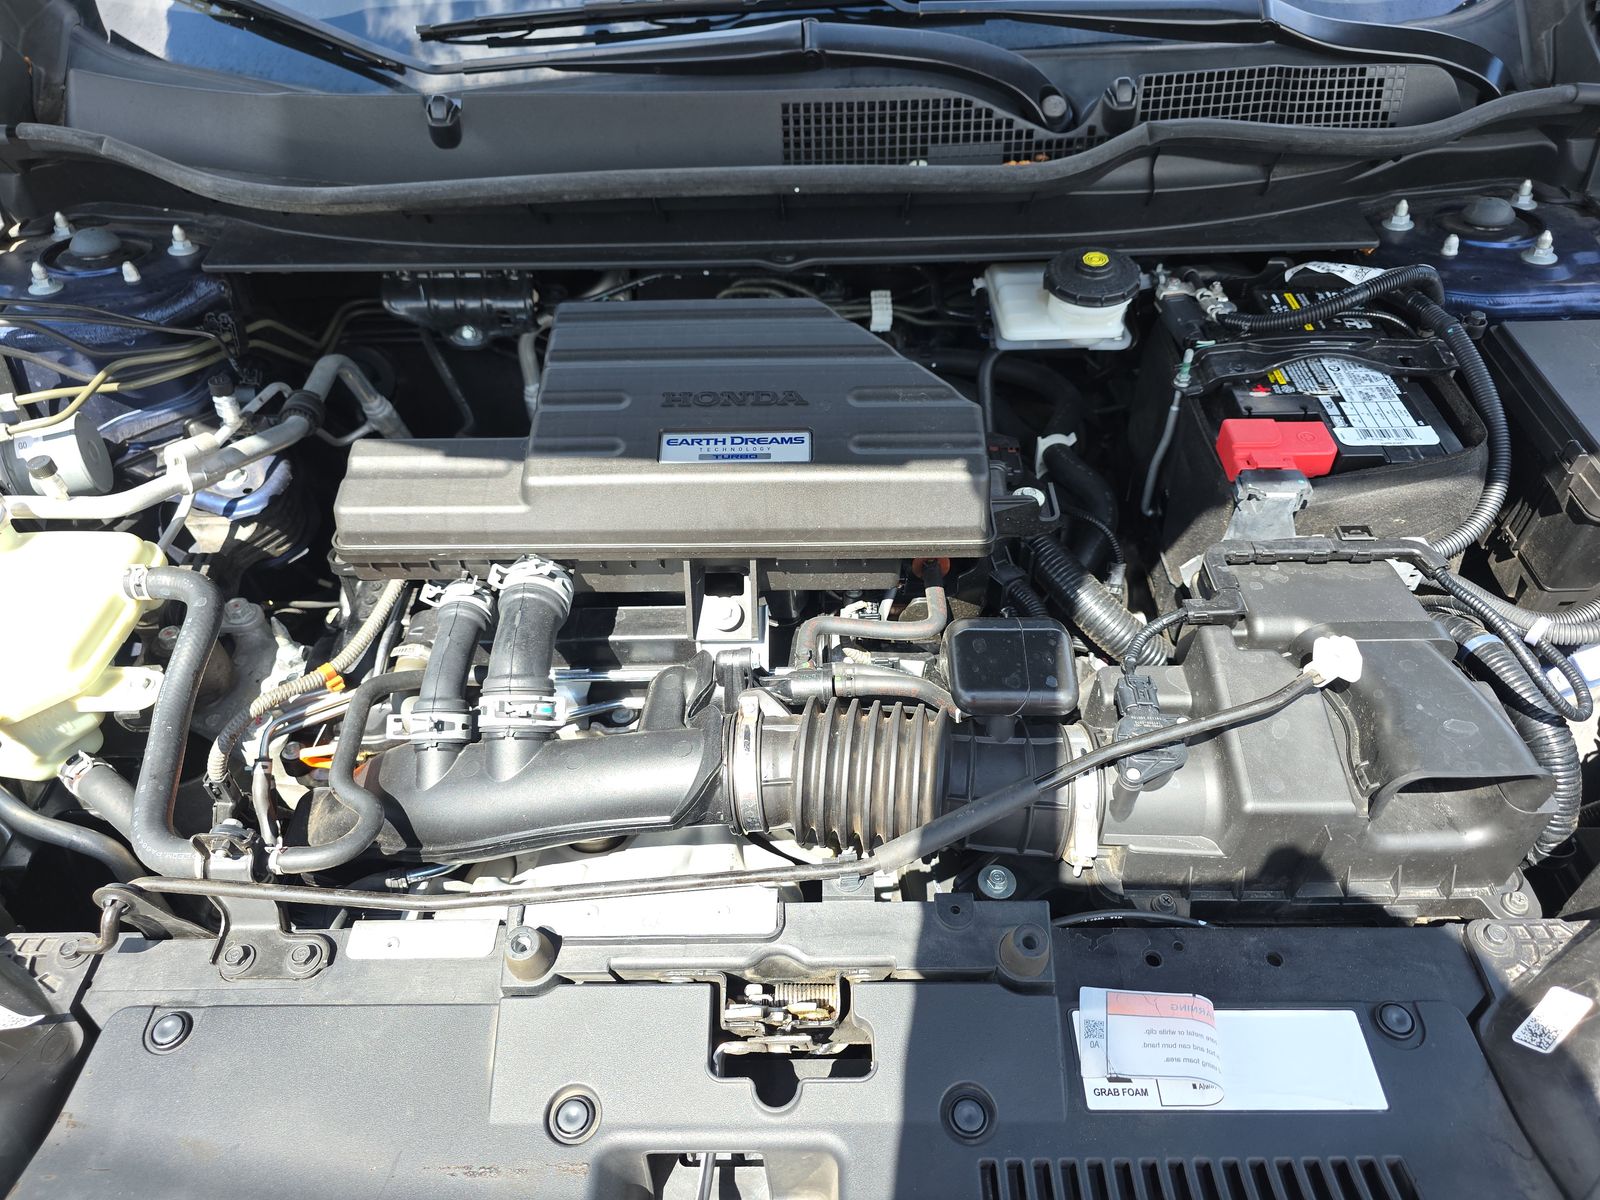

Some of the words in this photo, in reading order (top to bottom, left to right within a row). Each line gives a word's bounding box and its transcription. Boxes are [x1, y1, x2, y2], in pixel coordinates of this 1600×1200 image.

[660, 390, 809, 408] HONDA
[666, 437, 726, 446] EARTH
[730, 436, 805, 446] DREAMS
[1093, 1087, 1120, 1097] GRAB
[1122, 1087, 1149, 1097] FOAM
